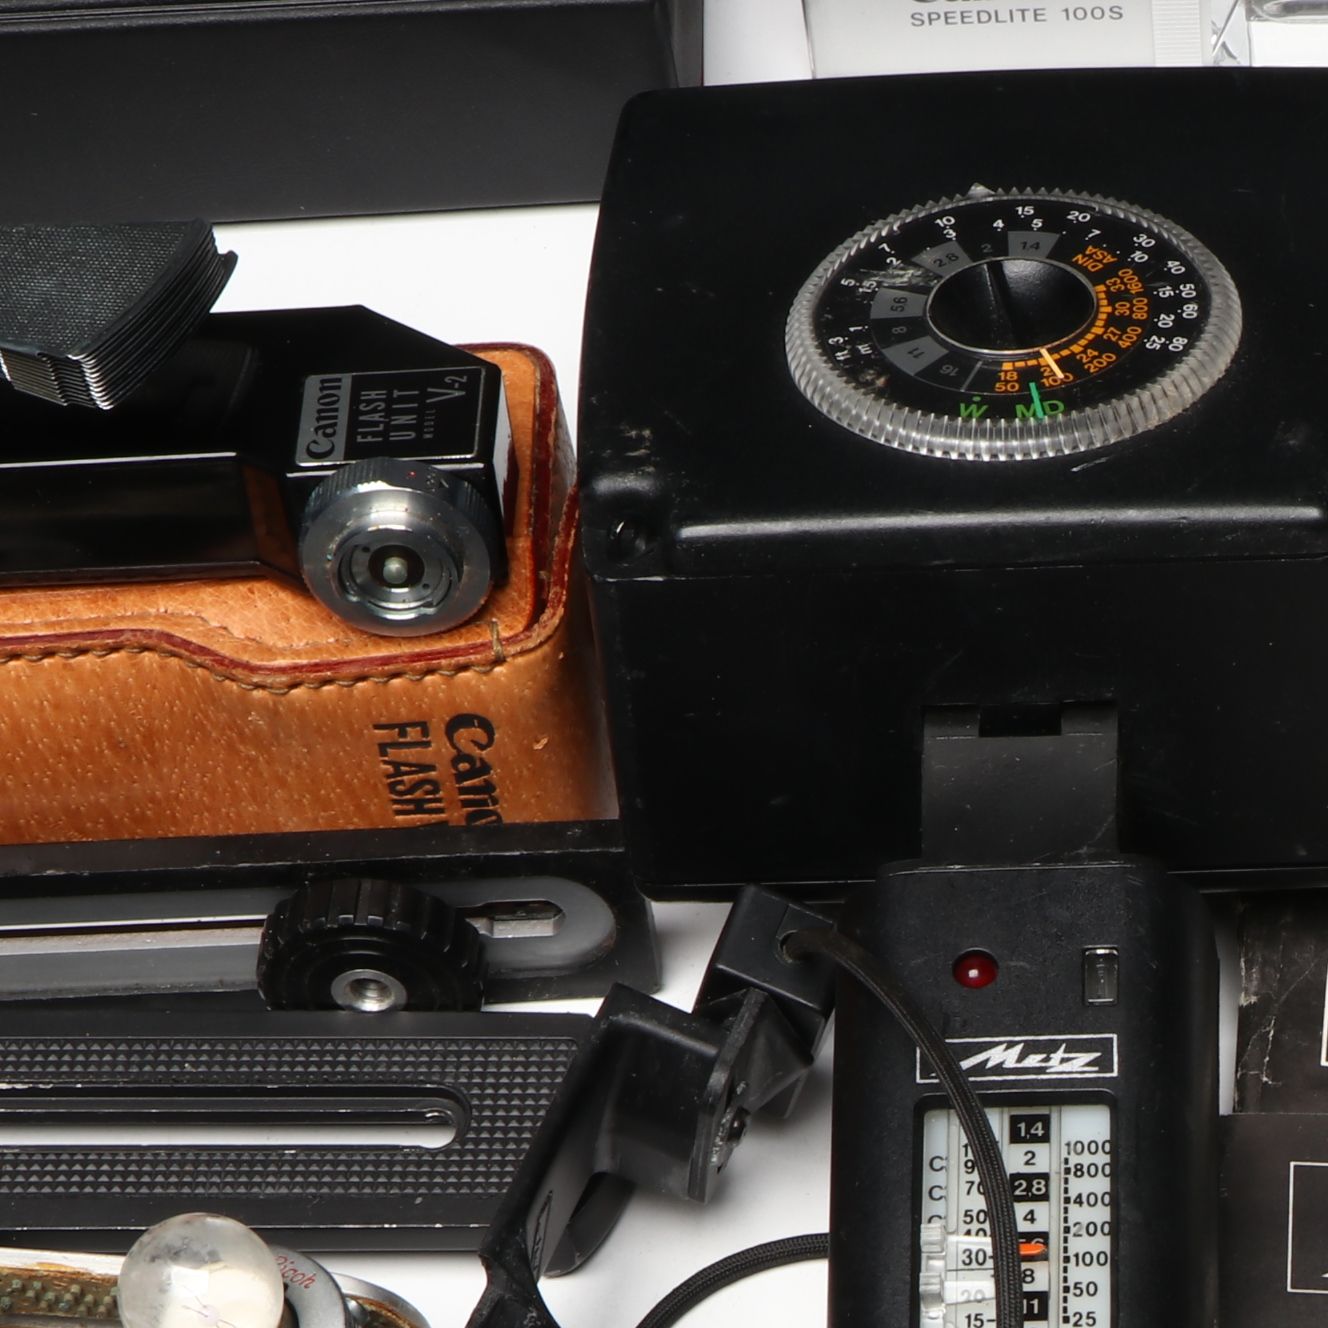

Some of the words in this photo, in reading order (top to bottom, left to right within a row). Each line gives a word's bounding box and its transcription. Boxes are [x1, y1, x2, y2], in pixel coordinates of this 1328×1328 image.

[910, 8, 1047, 27] SPEEDLITE
[1061, 5, 1125, 22] 100S
[1015, 205, 1035, 216] 15
[1066, 210, 1091, 223] 20
[934, 215, 956, 228] 10
[992, 218, 1005, 229] 4
[1031, 218, 1043, 229] 5
[943, 228, 956, 239] 3
[1087, 229, 1101, 238] 7
[1133, 233, 1156, 248] 30
[878, 242, 892, 253] 7
[1085, 245, 1118, 264] ASA
[1071, 253, 1105, 273] DIN
[1130, 250, 1149, 263] 10
[1166, 259, 1186, 275] 40
[840, 277, 855, 287] 5
[1105, 277, 1125, 293] 33
[1118, 268, 1145, 295] 1600
[1157, 285, 1175, 299] 15
[1179, 283, 1197, 299] 50
[1114, 301, 1131, 317] 30
[1132, 297, 1149, 321] 800
[1182, 303, 1199, 319] 60
[1157, 313, 1176, 329] 20
[891, 325, 908, 335] 8
[1103, 326, 1122, 342] 27
[1118, 325, 1142, 349] 400
[1145, 335, 1166, 351] 25
[1168, 336, 1188, 352] 80
[1076, 348, 1099, 363] 24
[1084, 352, 1117, 374] 200
[939, 364, 960, 377] 16
[1000, 371, 1018, 381] 18
[995, 382, 1019, 392] 50
[1041, 373, 1075, 387] 100
[425, 375, 468, 403] V-2
[356, 390, 388, 443] FLASH
[389, 390, 420, 441] UNIT
[959, 402, 989, 418] W
[306, 377, 342, 460] Canon
[372, 721, 446, 815] FLASH
[445, 713, 503, 825] Cano
[930, 1043, 1102, 1073] Metz
[1064, 1140, 1111, 1156] 1000
[1023, 1150, 1036, 1166] 2
[1072, 1162, 1111, 1178] 800
[1073, 1191, 1111, 1208] 400
[962, 1209, 988, 1225] 50
[1023, 1209, 1037, 1225] 4
[1072, 1221, 1111, 1237] 200
[961, 1248, 987, 1266] 30
[1072, 1251, 1108, 1267] 100
[1022, 1268, 1035, 1284] 8
[1072, 1281, 1098, 1297] 50
[965, 1313, 985, 1328] 15
[1072, 1311, 1097, 1328] 25
